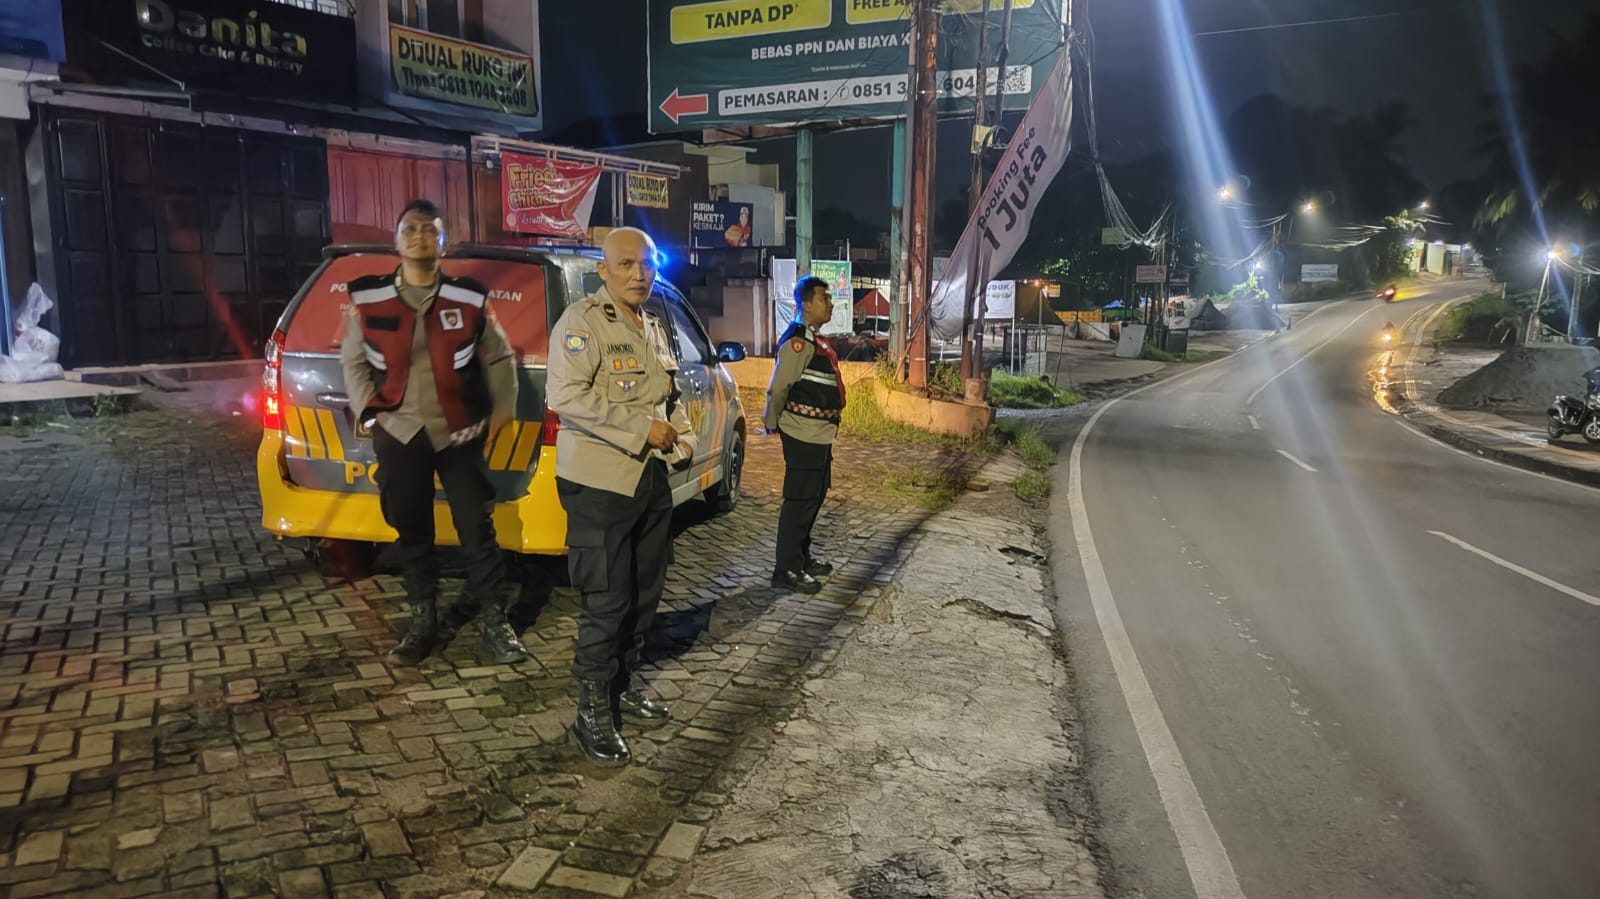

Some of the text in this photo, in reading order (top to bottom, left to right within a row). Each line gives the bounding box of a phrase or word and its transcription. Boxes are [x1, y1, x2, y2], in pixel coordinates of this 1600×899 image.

[135, 0, 307, 56] Danita
[705, 8, 764, 30] TANPA
[240, 50, 251, 64] &
[398, 35, 458, 71] DIJUAL
[461, 49, 503, 78] RUKO
[751, 45, 793, 60] BEBAS
[795, 42, 823, 56] PPN
[826, 38, 855, 53] DAN
[858, 33, 898, 49] BIAYA
[724, 88, 819, 109] PEMASARAN
[852, 82, 891, 98] 0851
[508, 164, 557, 189] Fried
[977, 127, 1036, 230] Booking Fee
[996, 145, 1047, 232] Juta
[509, 190, 558, 210] Chicken
[693, 202, 715, 212] KIRIM
